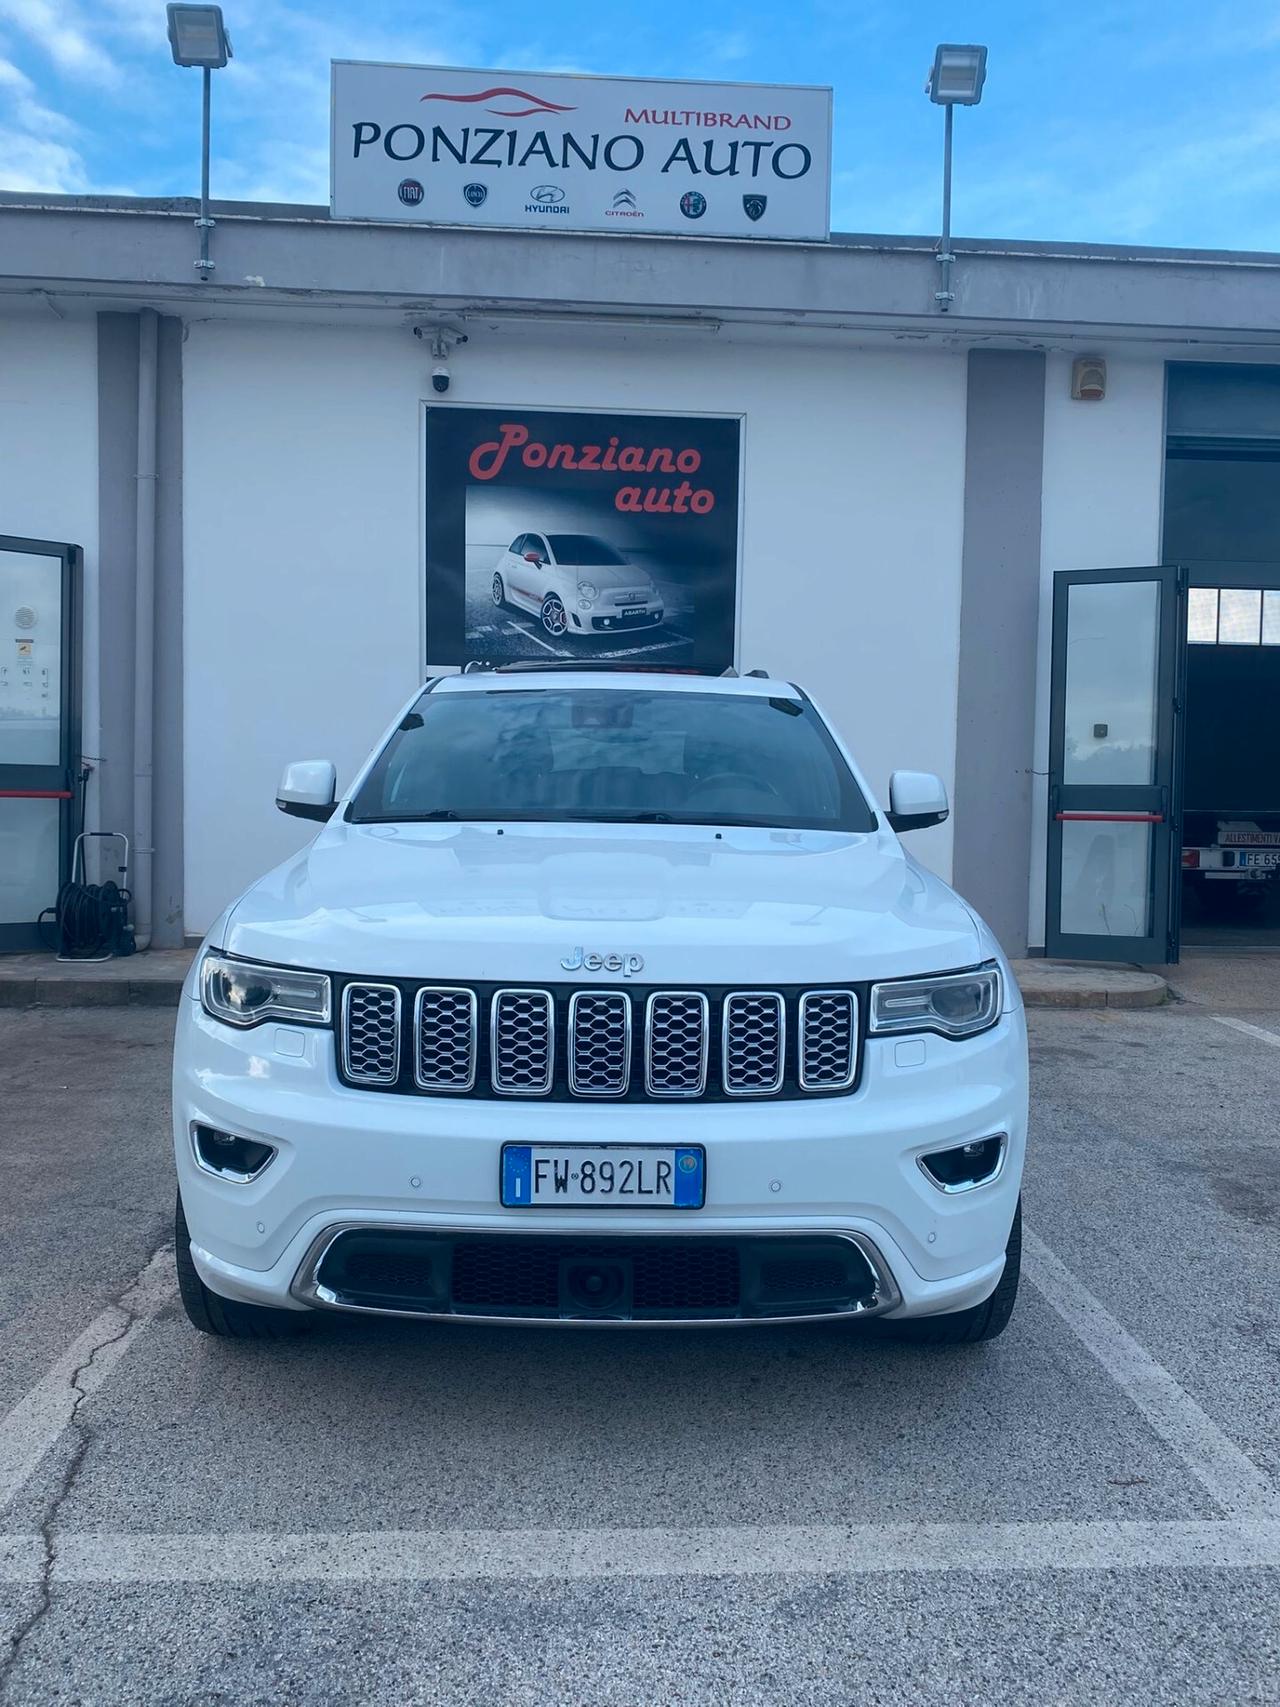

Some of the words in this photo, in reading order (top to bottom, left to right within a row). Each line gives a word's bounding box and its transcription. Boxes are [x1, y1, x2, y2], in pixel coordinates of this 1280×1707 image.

[624, 108, 792, 131] MULTIBRAND
[351, 121, 645, 172] PONZIANO
[660, 137, 812, 179] AUTO
[403, 186, 419, 200] FIAT
[524, 205, 570, 214] HYUNDAI
[468, 424, 702, 481] Ponziano
[614, 481, 716, 514] auto
[1247, 853, 1260, 865] FE
[560, 946, 645, 978] Jeep
